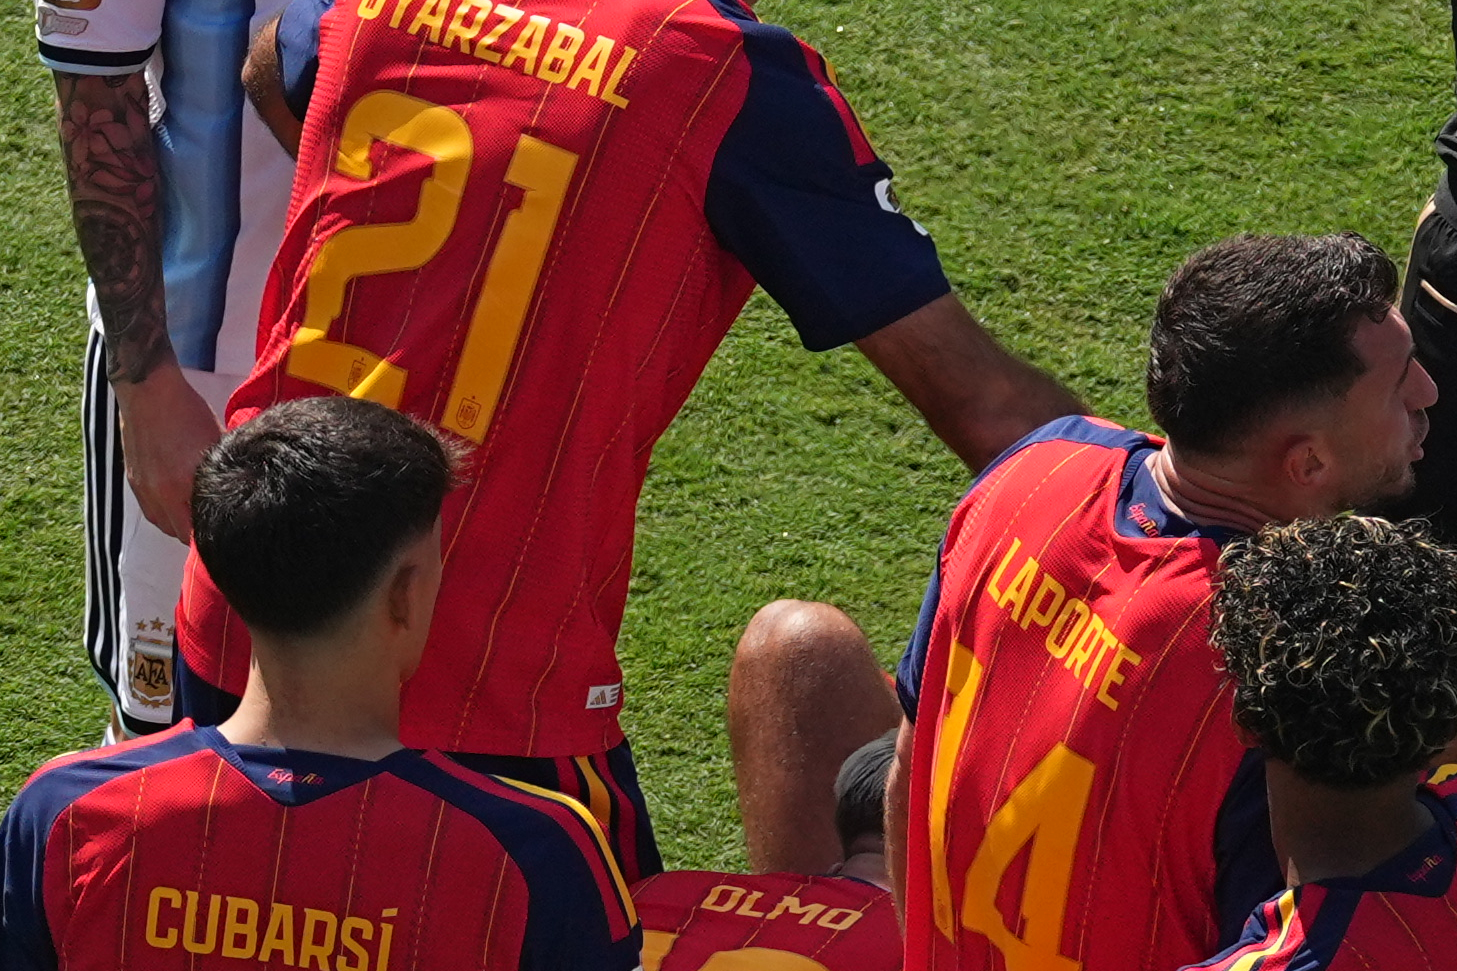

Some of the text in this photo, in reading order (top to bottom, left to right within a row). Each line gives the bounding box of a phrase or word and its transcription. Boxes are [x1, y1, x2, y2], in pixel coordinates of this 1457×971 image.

[286, 89, 579, 444] 21
[986, 537, 1145, 711] LAPORTE
[134, 653, 169, 690] AFA
[145, 885, 398, 971] CUBARSÍ
[701, 884, 864, 931] OLMO
